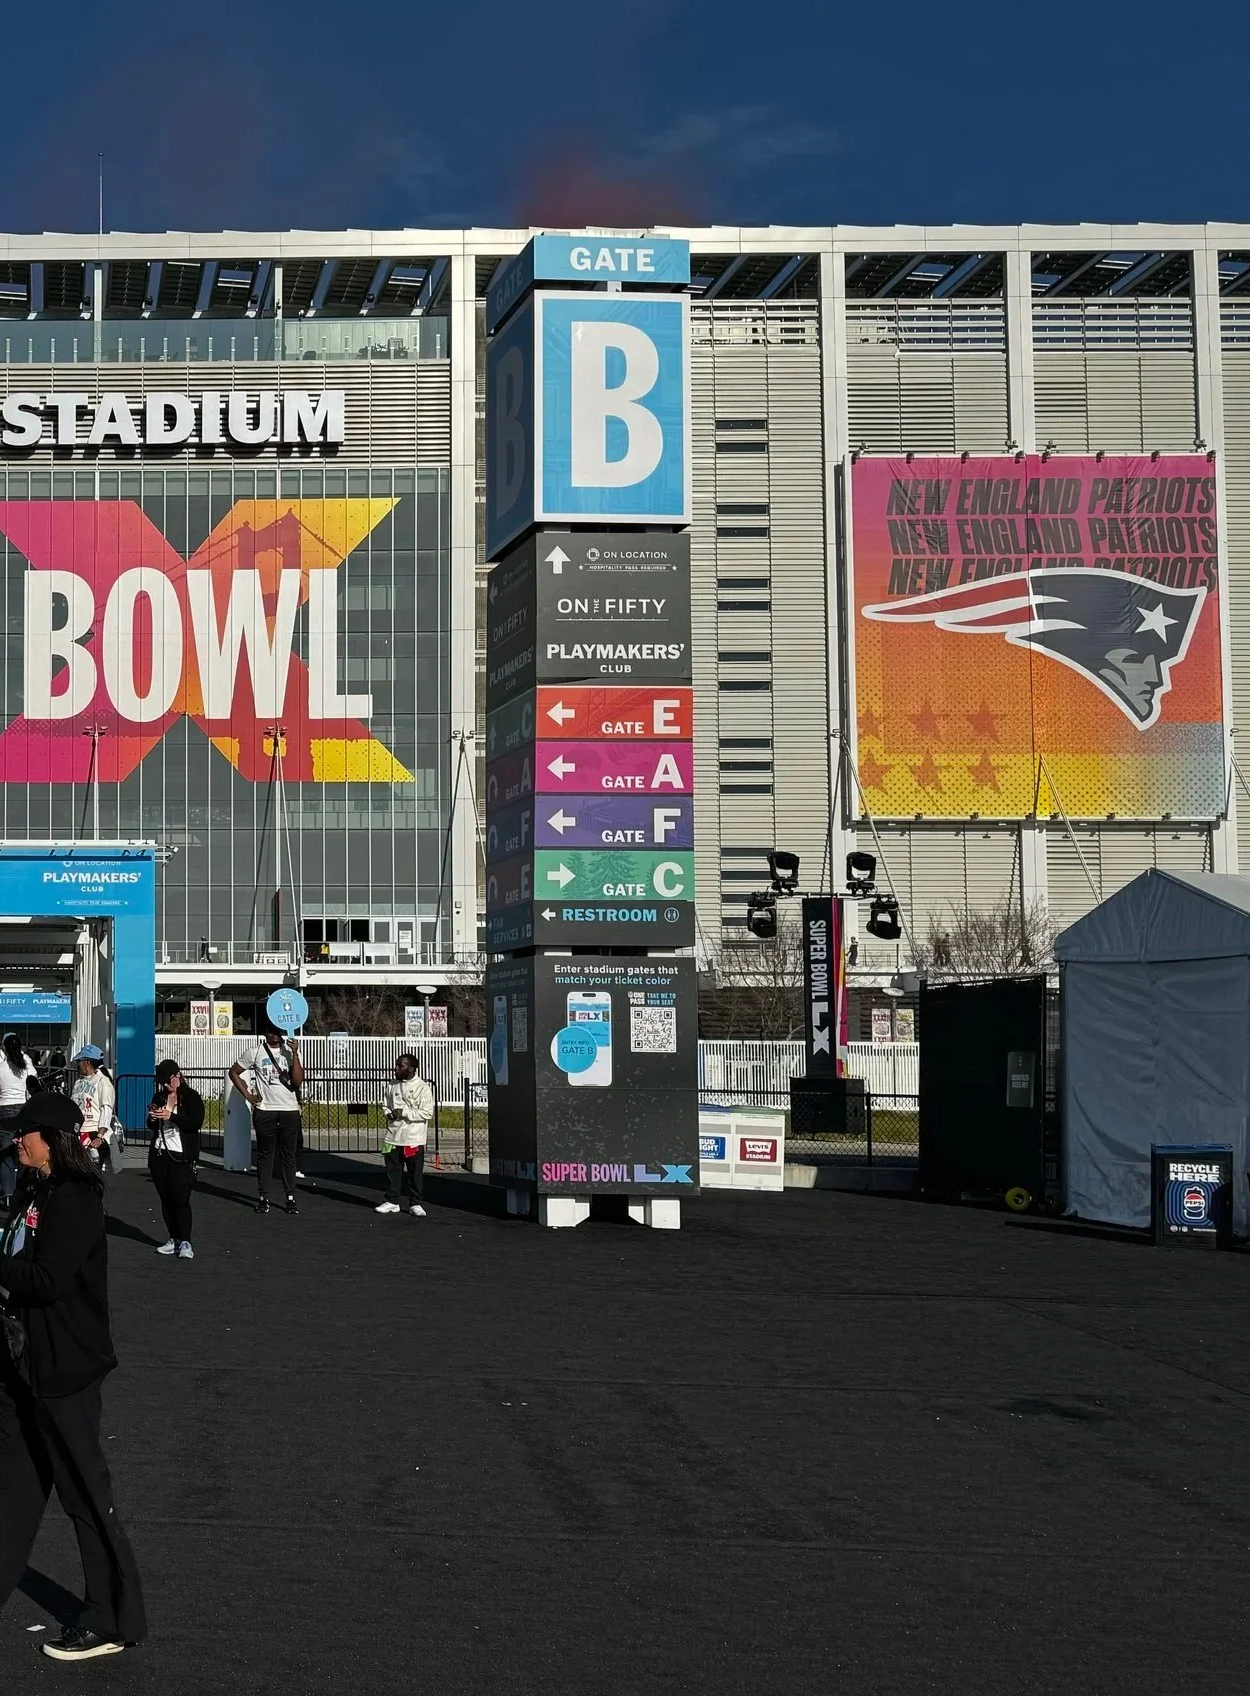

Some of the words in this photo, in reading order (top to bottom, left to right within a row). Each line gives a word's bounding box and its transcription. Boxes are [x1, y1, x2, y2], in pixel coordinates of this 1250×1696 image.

[570, 247, 655, 272] GATE
[496, 261, 524, 311] GATE
[1, 390, 345, 446] STADIUM
[571, 321, 663, 488] B
[496, 346, 526, 520] B
[886, 478, 951, 516] NEW
[955, 477, 1082, 516] ENGLAND
[1087, 476, 1216, 515] PATRIOTS
[887, 518, 952, 555] NEW
[956, 518, 1082, 555] ENGLAND
[1087, 517, 1217, 555] PATRIOTS
[603, 551, 617, 559] ON
[620, 551, 668, 560] LOCATION
[887, 558, 952, 595] NEW
[557, 598, 589, 614] ON
[605, 598, 666, 614] FIFTY
[25, 566, 373, 723] BOWL
[600, 663, 632, 673] CLUB
[601, 721, 645, 734] GATE
[653, 700, 681, 734] E
[521, 756, 531, 793] A
[601, 776, 645, 789] GATE
[651, 754, 684, 789] A
[521, 810, 530, 847] F
[601, 830, 645, 843] GATE
[653, 808, 681, 843] F
[521, 864, 530, 899] E
[602, 883, 646, 896] GATE
[653, 862, 684, 898] C
[562, 909, 657, 921] RESTROOM
[810, 919, 827, 960] SUPER
[554, 965, 581, 973] Enter
[584, 965, 625, 974] stadium
[627, 966, 655, 976] gates
[658, 966, 679, 974] that
[555, 976, 586, 984] match
[589, 976, 612, 986] your
[614, 976, 643, 984] ticket
[646, 976, 671, 984] color
[811, 963, 828, 999] BOWL
[278, 1014, 293, 1022] GATE
[812, 1002, 830, 1055] LX
[542, 1163, 587, 1182] SUPER
[592, 1164, 631, 1182] BOWL
[634, 1164, 694, 1183] LX
[1170, 1163, 1219, 1174] RECYCLE
[1170, 1172, 1219, 1183] HERE
